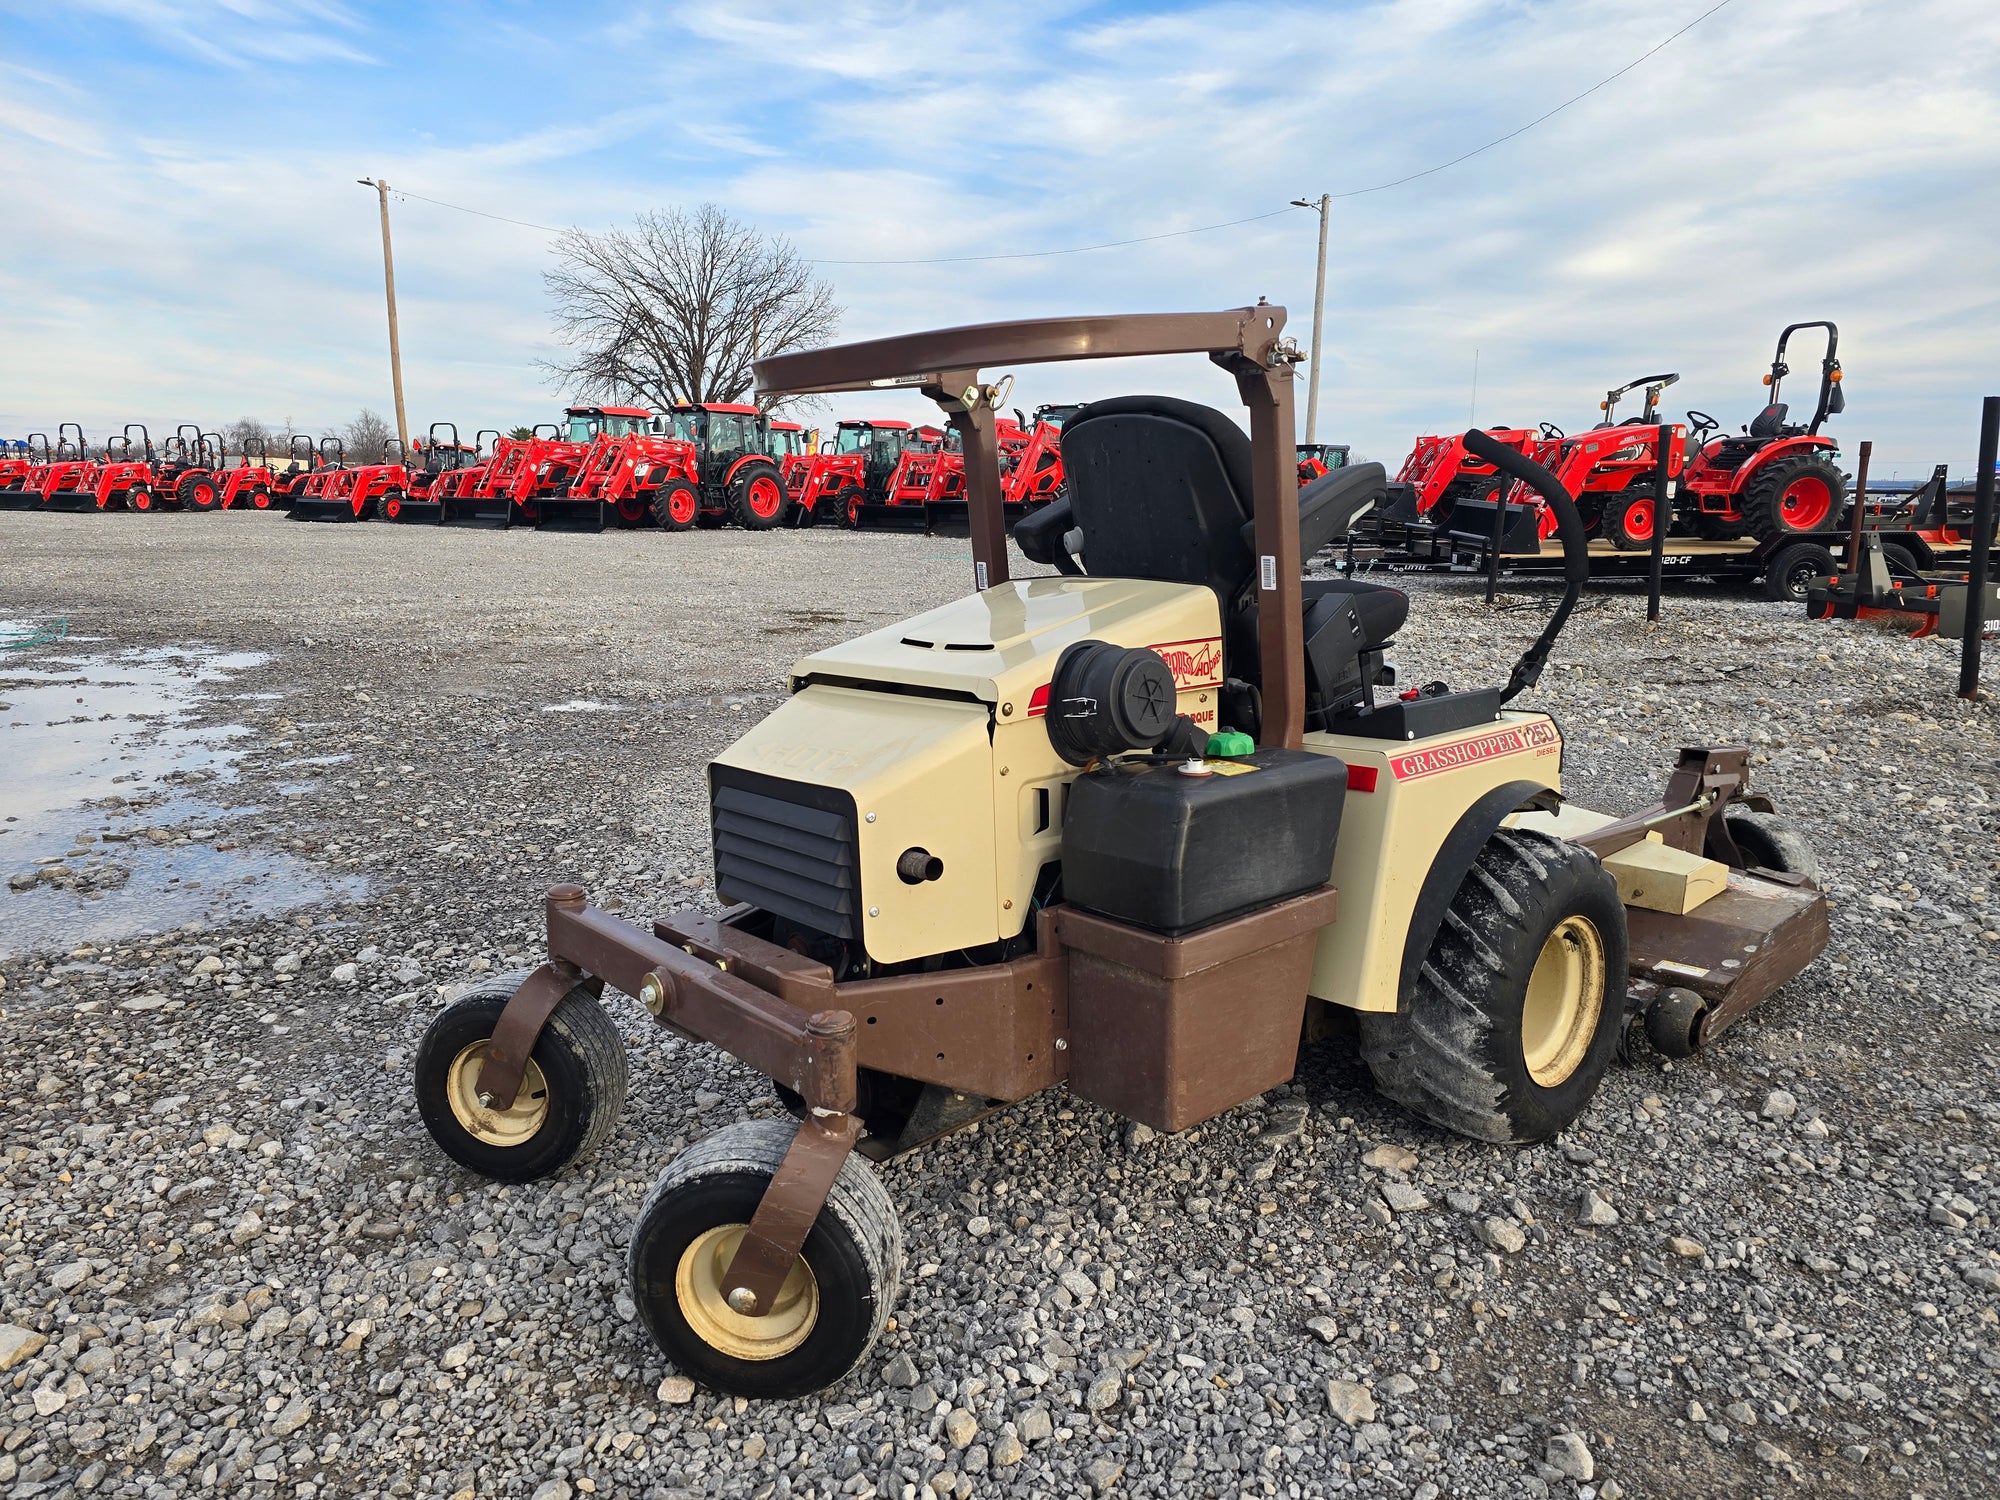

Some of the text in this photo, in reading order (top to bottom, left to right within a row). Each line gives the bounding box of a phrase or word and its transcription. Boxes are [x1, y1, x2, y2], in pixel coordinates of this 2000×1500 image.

[1983, 619, 2000, 631] 310
[1178, 710, 1214, 723] RQUE
[1401, 732, 1519, 776] GRASSHOPPER
[1536, 746, 1557, 757] DIESEL
